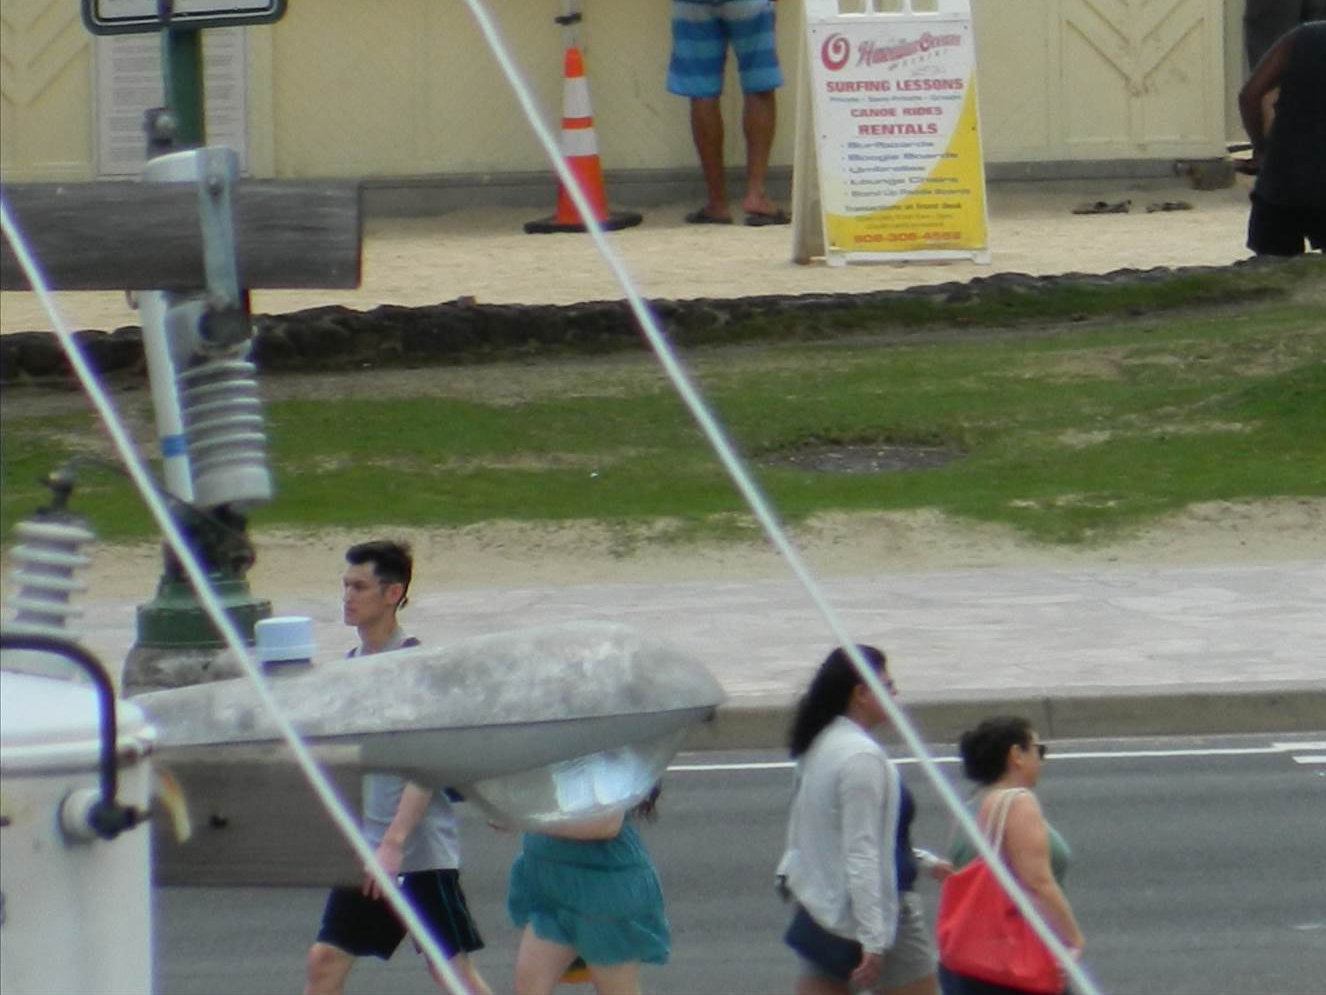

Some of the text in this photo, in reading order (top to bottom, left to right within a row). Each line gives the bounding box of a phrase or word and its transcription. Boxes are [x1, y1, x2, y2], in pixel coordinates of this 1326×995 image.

[826, 78, 964, 93] SURFING LESSONS
[850, 105, 943, 118] CANOE RIDES
[858, 122, 938, 135] RENTALS
